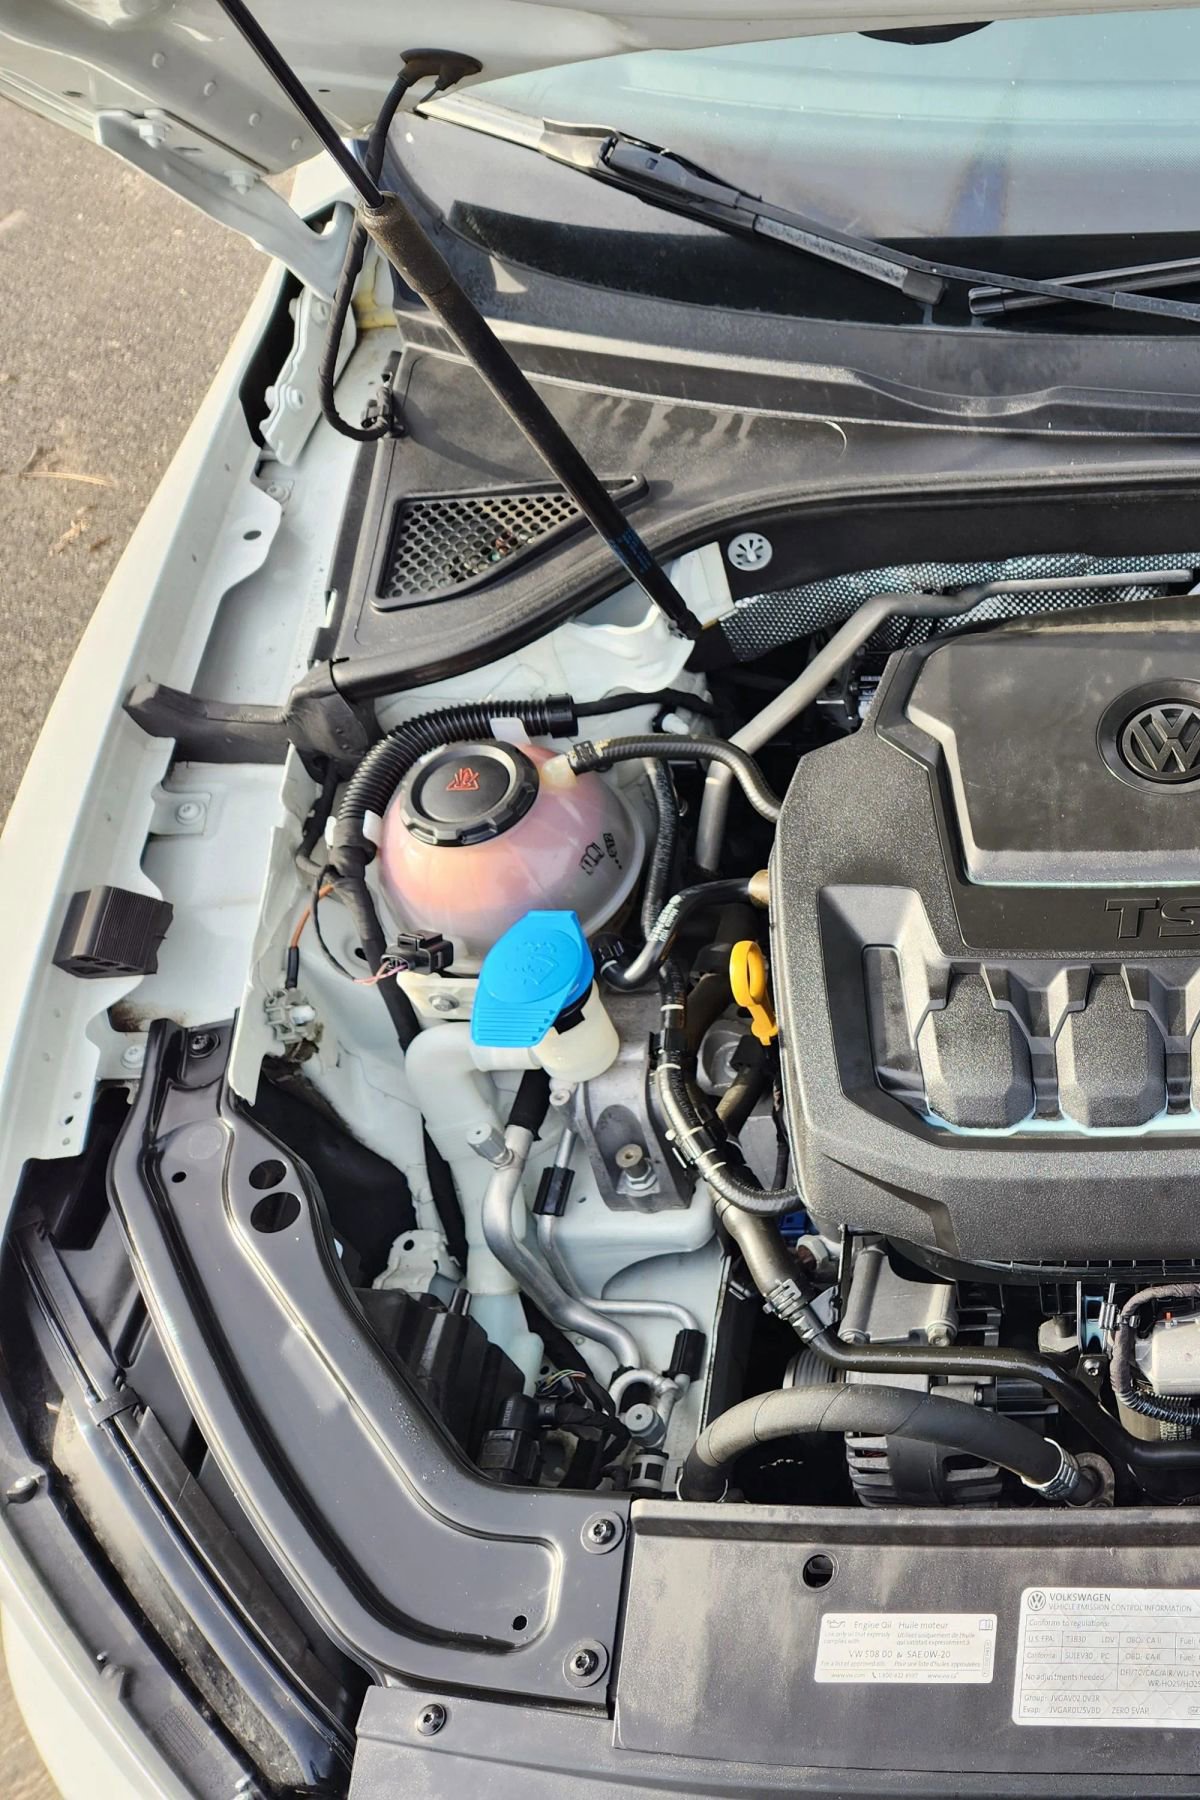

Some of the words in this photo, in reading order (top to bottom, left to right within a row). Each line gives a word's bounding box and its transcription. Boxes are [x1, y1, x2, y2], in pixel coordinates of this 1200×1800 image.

[1049, 1592, 1111, 1602] VOLKSWAGEN
[1049, 1603, 1072, 1611] VEHICLE
[1072, 1603, 1109, 1611] EMISSION
[1111, 1604, 1142, 1612] CONTROL
[1145, 1604, 1193, 1613] INFORMATION
[854, 1621, 879, 1630] Engine
[881, 1621, 892, 1629] Oil
[899, 1621, 918, 1629] Huile
[849, 1650, 863, 1658] VW
[865, 1650, 879, 1658] 508
[882, 1650, 892, 1658] 00
[907, 1650, 923, 1659] SAE
[923, 1650, 951, 1659] 0W-20
[1101, 1652, 1110, 1660] PC
[1036, 1672, 1078, 1683] adjustments
[1112, 1706, 1129, 1714] ZERO
